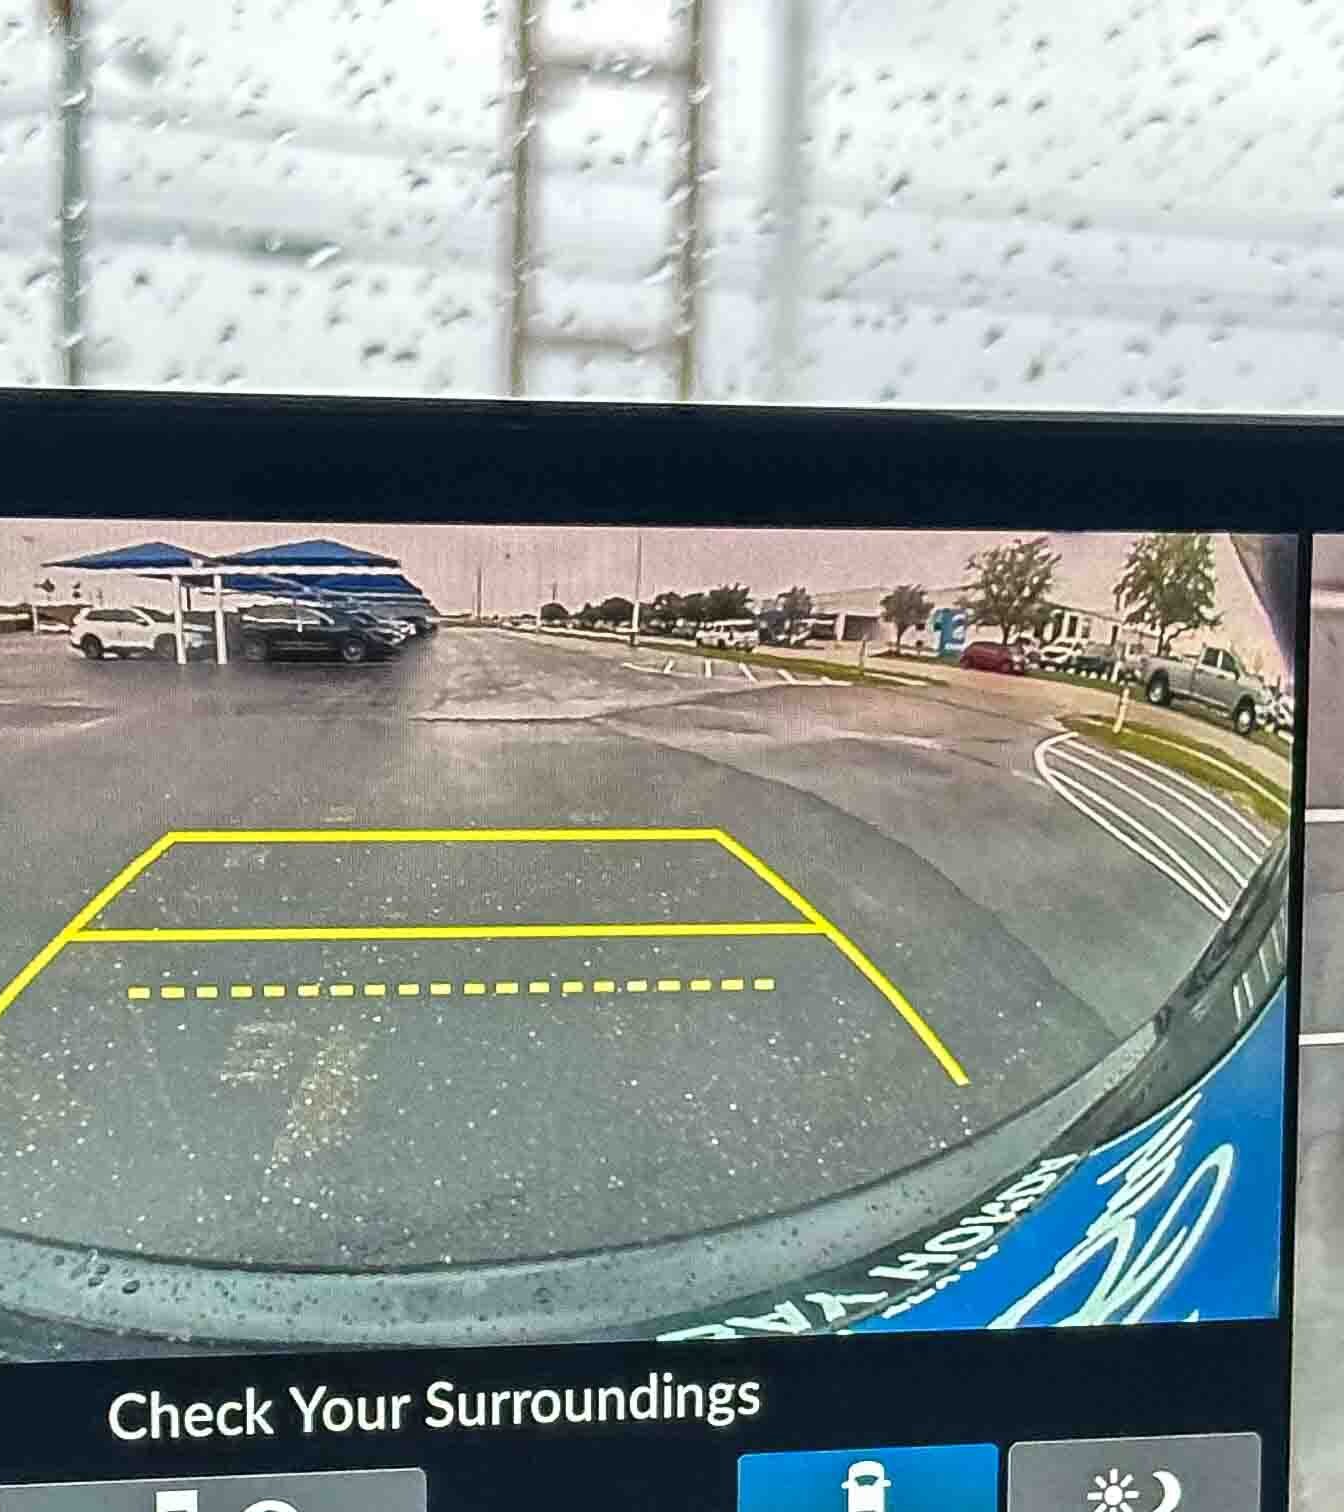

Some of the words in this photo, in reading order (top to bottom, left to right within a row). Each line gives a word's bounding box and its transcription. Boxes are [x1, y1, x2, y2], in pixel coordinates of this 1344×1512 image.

[108, 1387, 274, 1441] Check
[290, 1385, 411, 1433] Your
[425, 1372, 761, 1426] Surroundings
